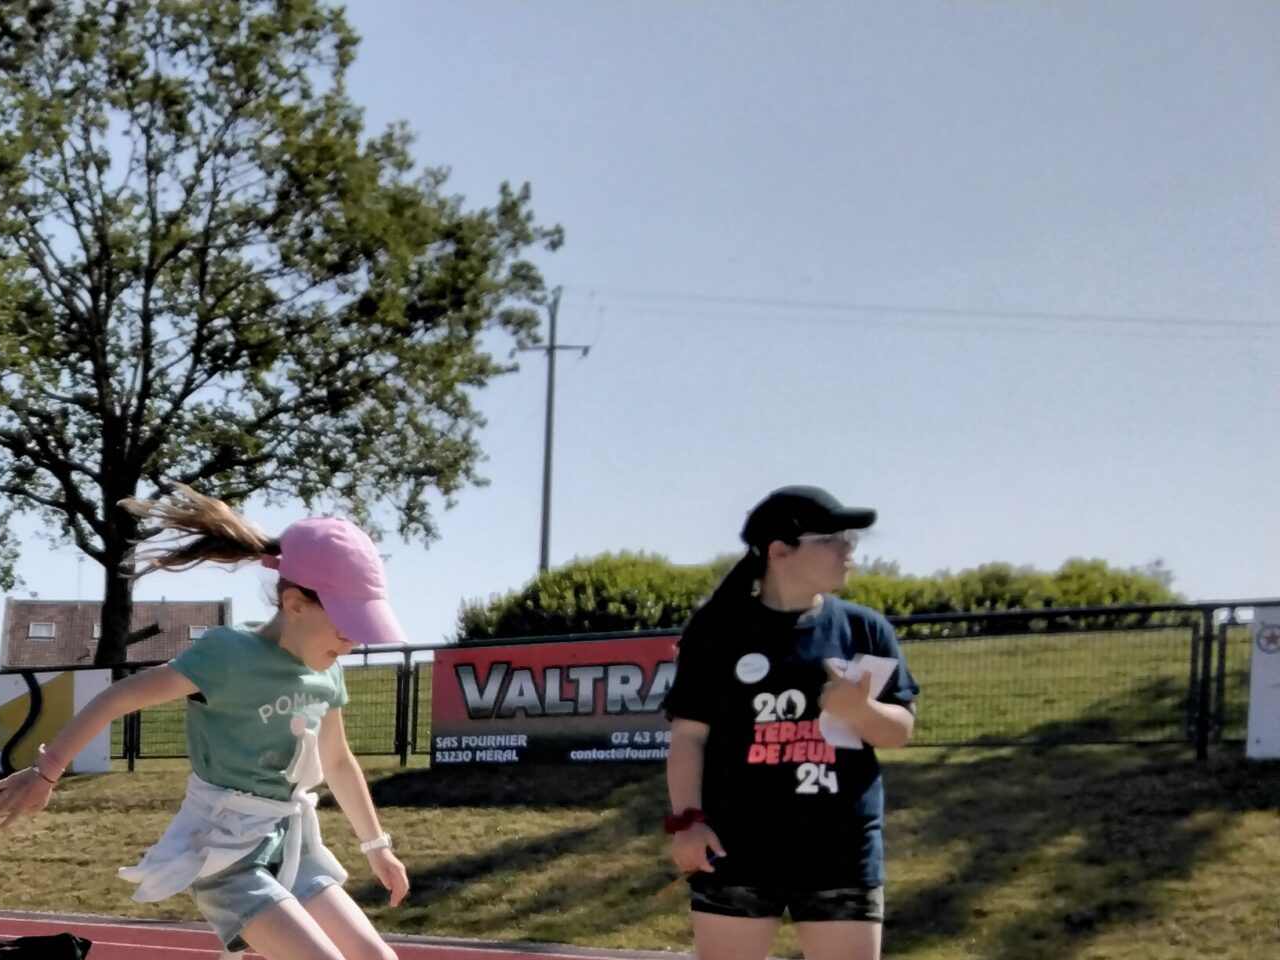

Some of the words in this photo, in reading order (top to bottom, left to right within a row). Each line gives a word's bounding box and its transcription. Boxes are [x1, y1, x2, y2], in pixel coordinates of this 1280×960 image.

[753, 689, 806, 722] 20
[435, 736, 458, 748] SAS
[461, 734, 528, 748] FOURNIER
[634, 731, 650, 743] 43
[435, 750, 472, 762] 53230
[747, 743, 780, 765] DE
[795, 762, 839, 793] 24
